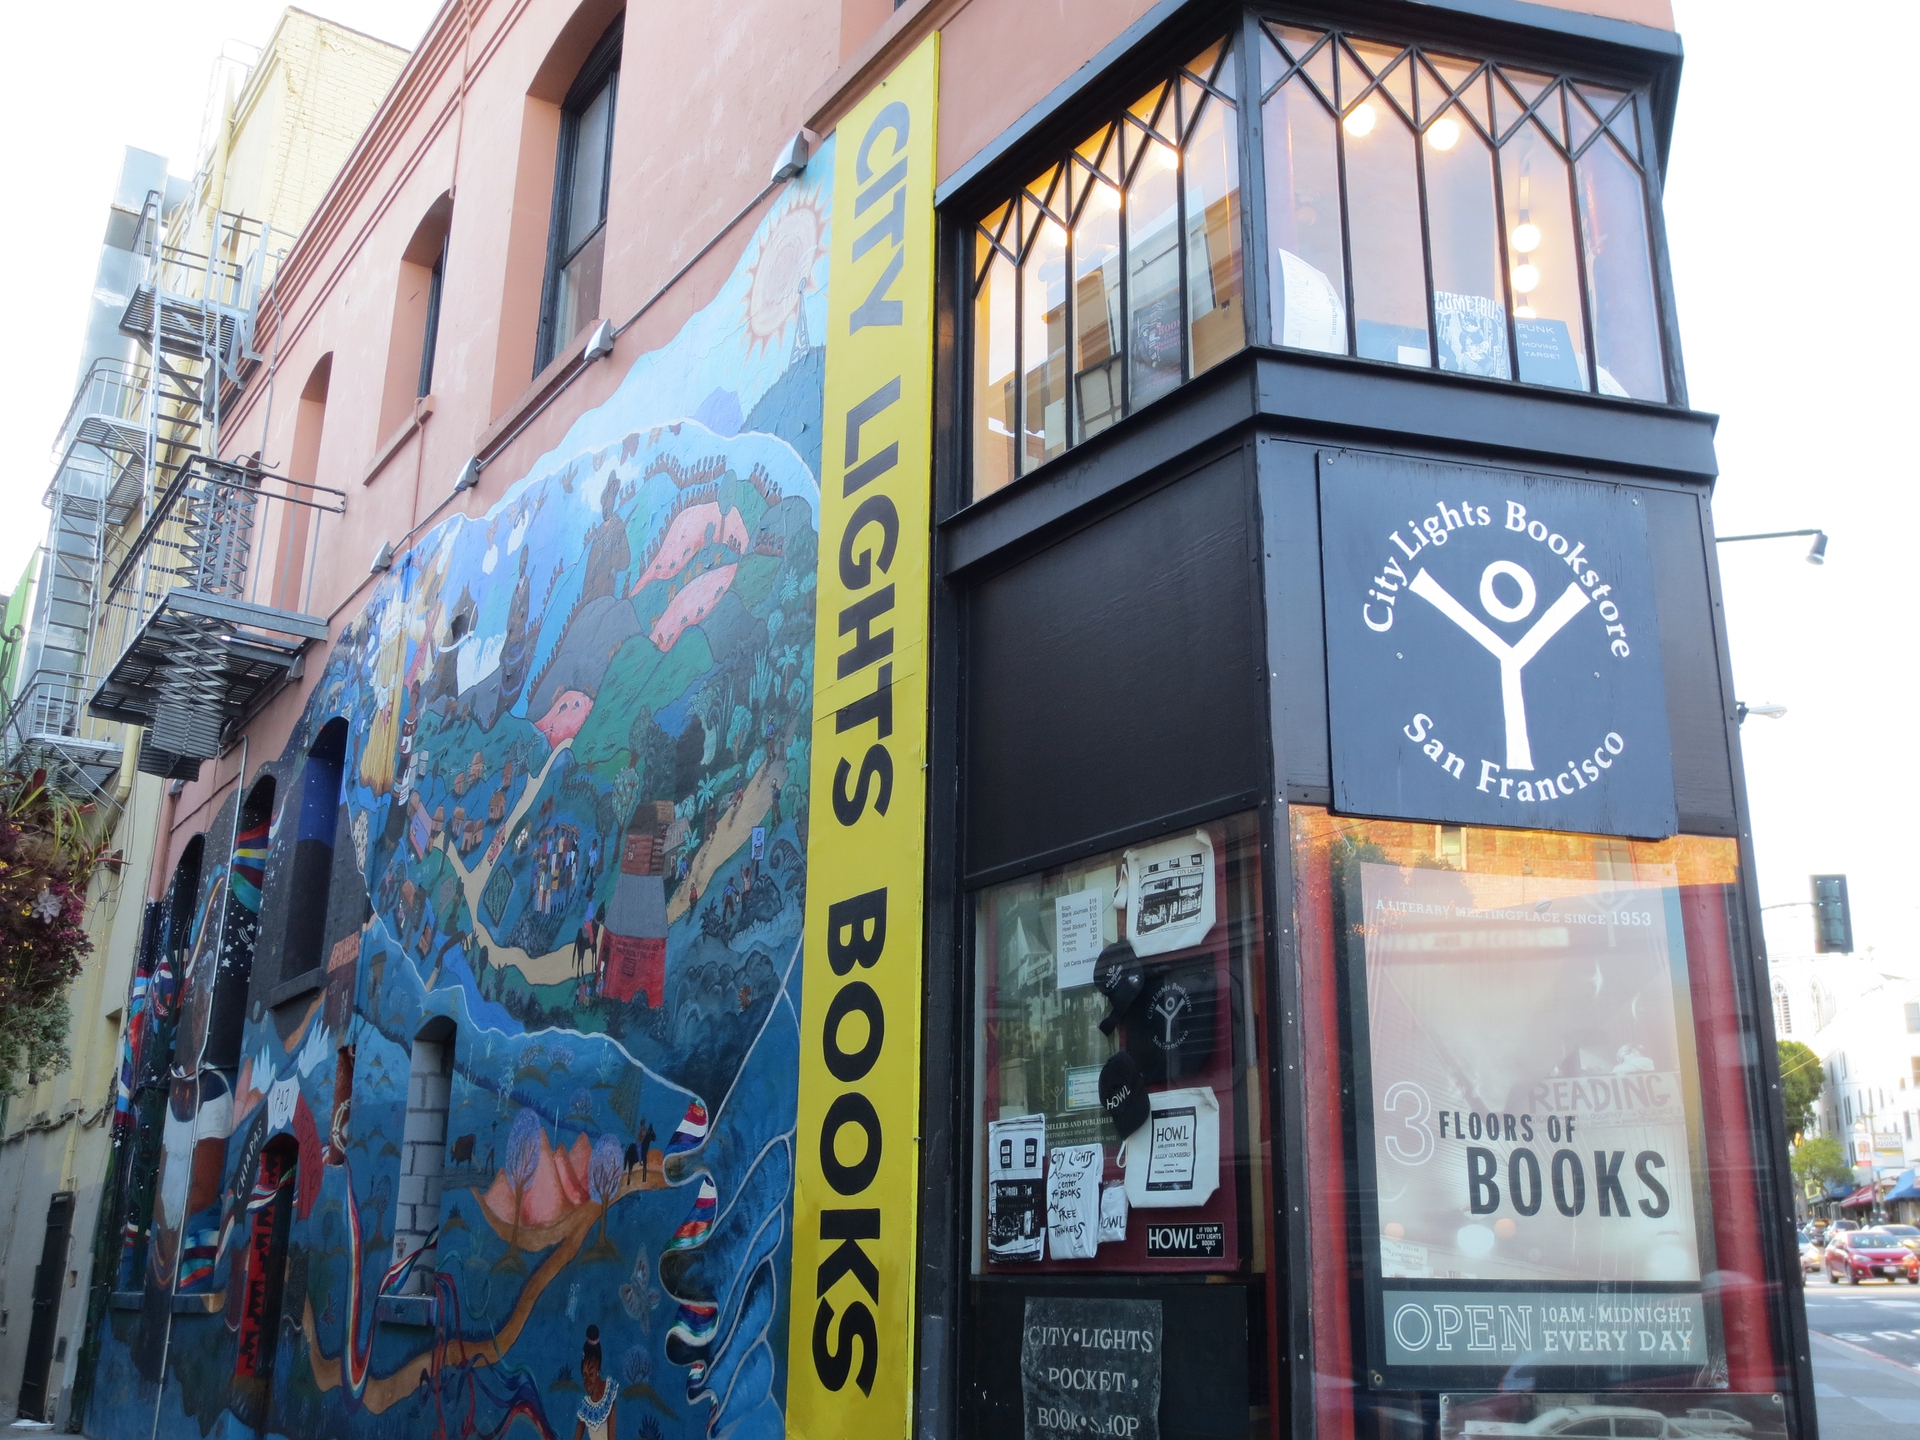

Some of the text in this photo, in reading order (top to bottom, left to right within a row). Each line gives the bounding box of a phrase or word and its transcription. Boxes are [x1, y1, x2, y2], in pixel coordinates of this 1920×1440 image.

[1435, 291, 1503, 322] COMETBUS
[1517, 323, 1555, 334] PUNK
[1521, 342, 1559, 351] MOVING
[1524, 351, 1561, 360] TARGET
[1363, 499, 1631, 659] City Lights Bookstore
[812, 101, 910, 1398] CITY LIGHTS BOOKS
[1403, 712, 1624, 802] San Francisco
[1375, 900, 1652, 926] A LITERARY MEETINGPLACE SINCE 1953
[1152, 985, 1171, 1002] Lights
[274, 1088, 290, 1112] PAZ
[1106, 1085, 1131, 1111] HOWL
[1527, 1074, 1671, 1114] READING
[1045, 1117, 1114, 1131] SELLERS AND PUBLISHER
[1156, 1125, 1189, 1142] HOWL
[1384, 1081, 1435, 1166] 3
[1438, 1111, 1576, 1143] FLOORS OF
[236, 1120, 262, 1199] CHIAPAS
[1069, 1151, 1095, 1168] LIGHTS
[1060, 1188, 1082, 1199] BOOKS
[1466, 1146, 1670, 1219] BOOKS
[1058, 1206, 1077, 1222] FREE
[1148, 1228, 1197, 1249] HOWL
[1393, 1304, 1533, 1352] OPEN
[1543, 1330, 1694, 1353] EVERY DAY
[1048, 1367, 1126, 1393] POCKET
